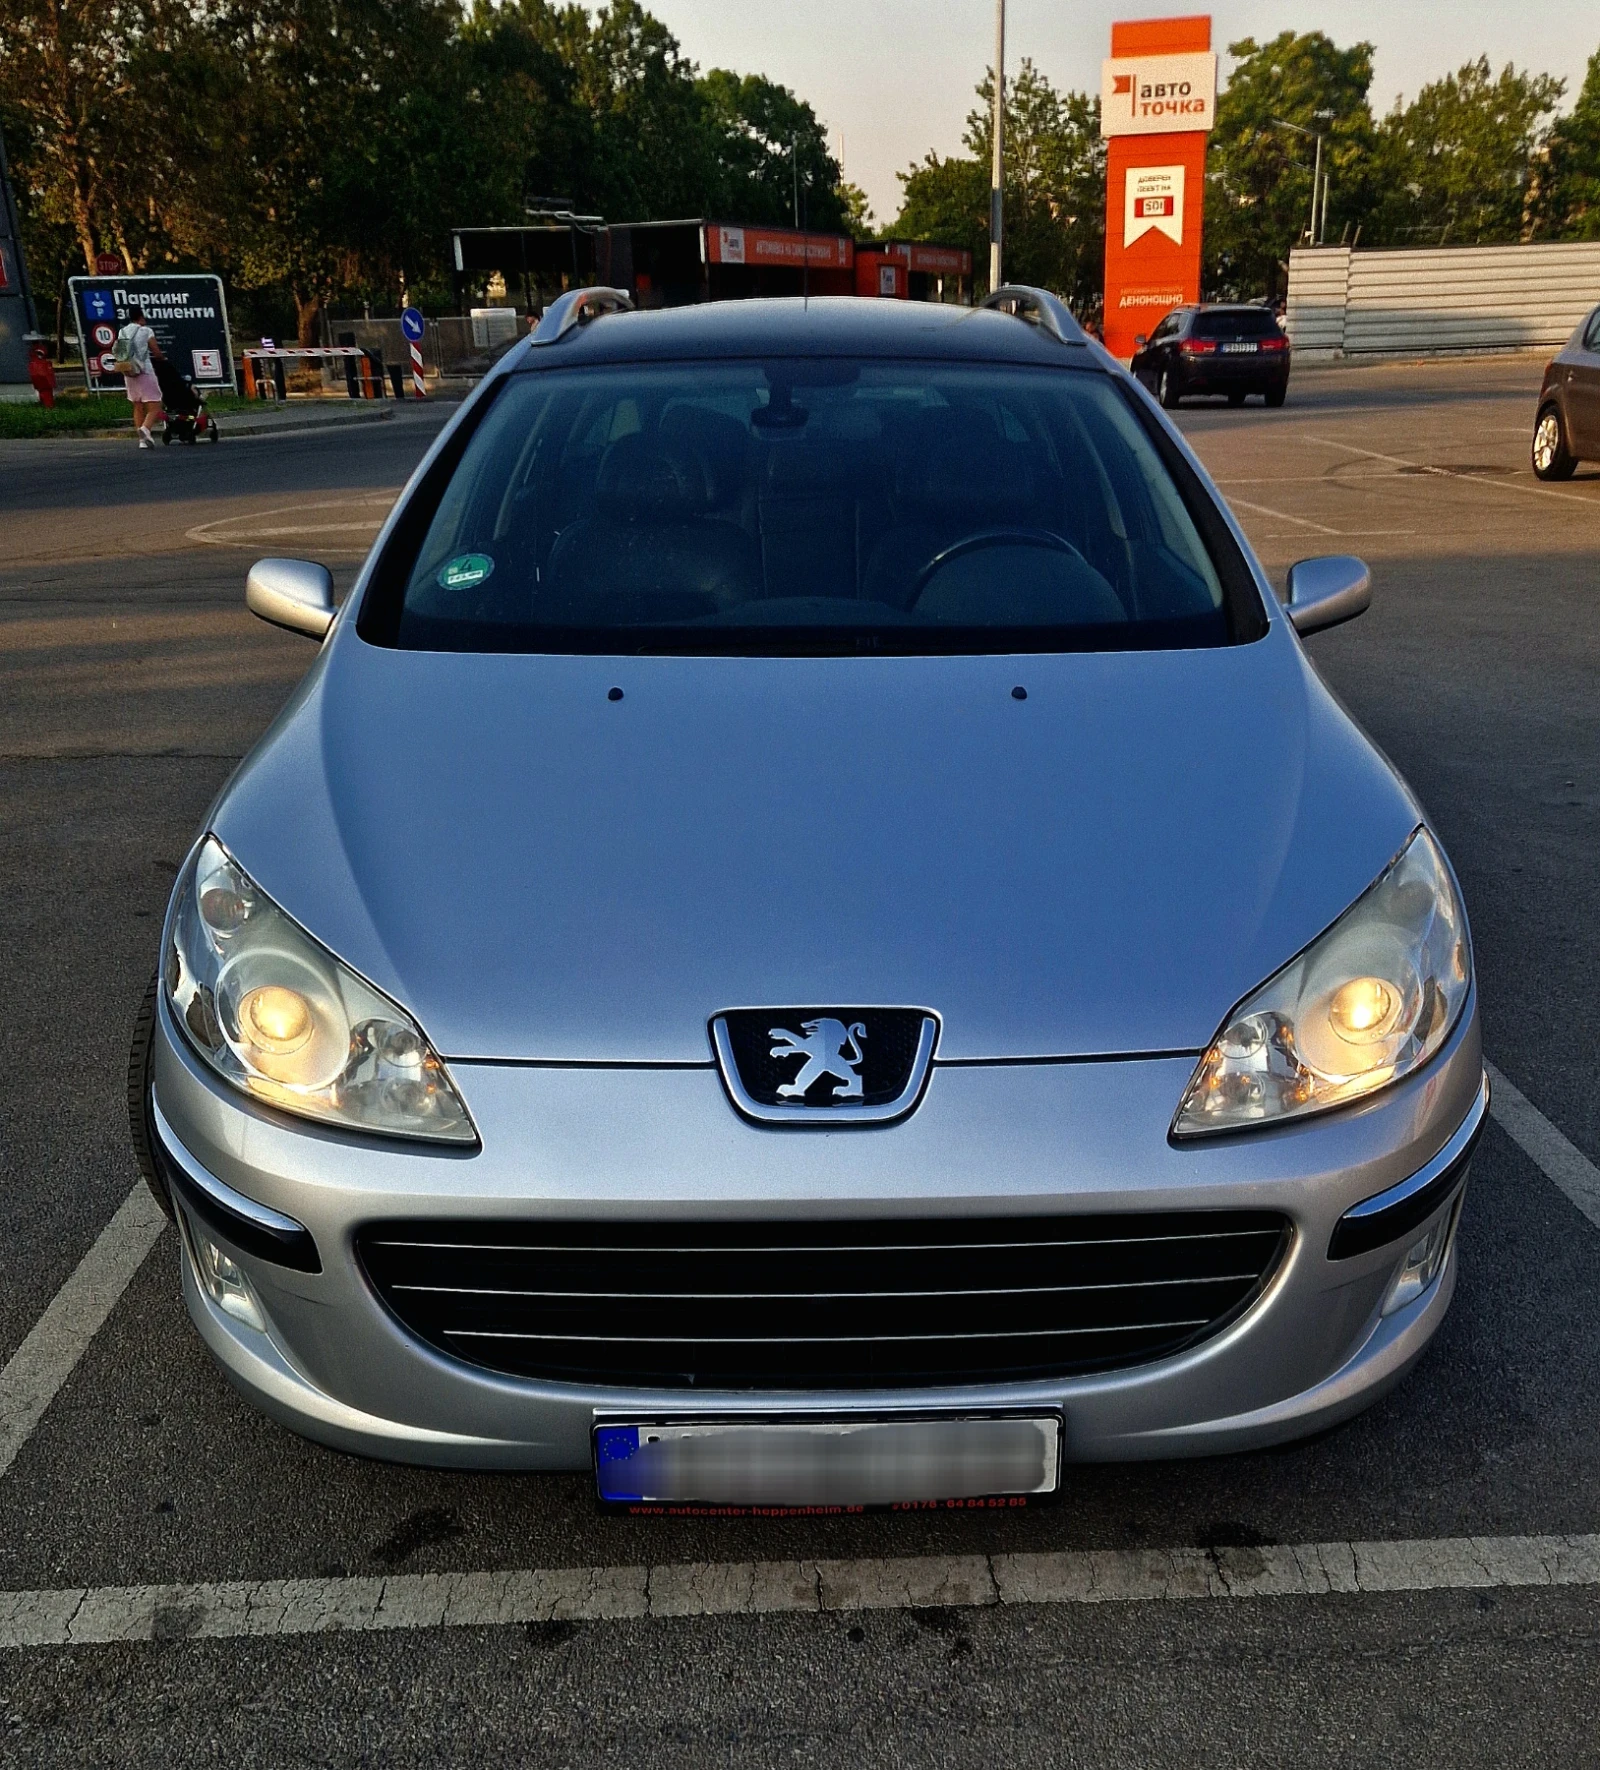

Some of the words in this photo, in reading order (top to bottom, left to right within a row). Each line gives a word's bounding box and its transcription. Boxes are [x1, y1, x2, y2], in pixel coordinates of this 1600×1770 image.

[1141, 82, 1191, 98] авто
[1141, 98, 1205, 116] точка
[99, 261, 119, 271] STOP
[113, 289, 190, 308] Паркинг
[141, 307, 215, 319] клиенти
[98, 330, 111, 341] 10
[629, 1505, 864, 1516] www.autocenter-heppenheim.de
[967, 1499, 985, 1507] 84
[988, 1498, 1006, 1507] 52
[1009, 1497, 1027, 1506] 85
